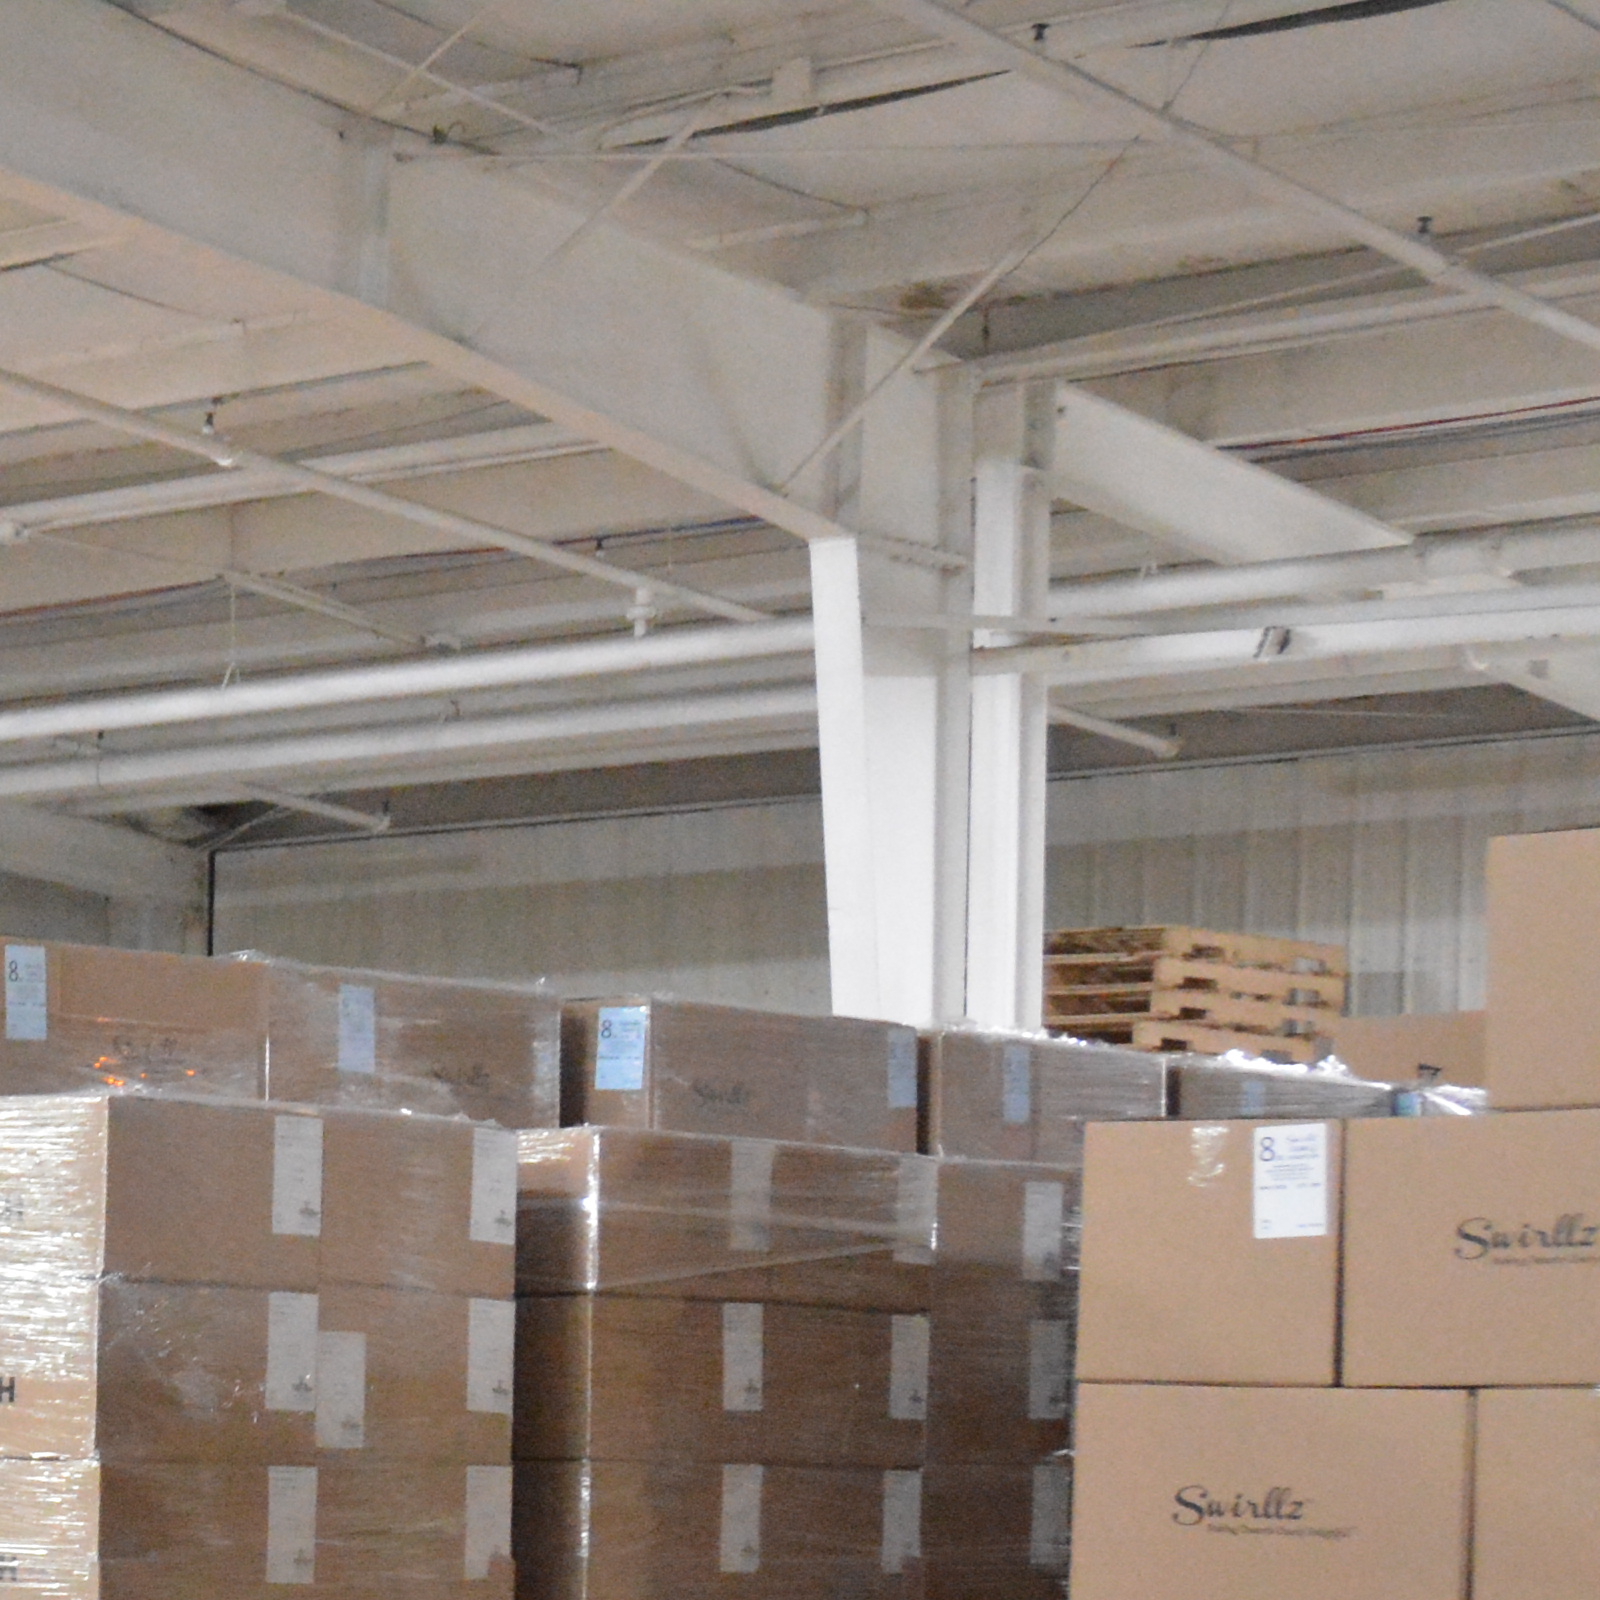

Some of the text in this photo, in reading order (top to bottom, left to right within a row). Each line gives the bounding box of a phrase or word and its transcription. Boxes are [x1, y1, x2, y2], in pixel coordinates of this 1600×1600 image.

[8, 961, 19, 983] 8
[601, 1019, 612, 1040] 8
[1260, 1136, 1275, 1161] 8
